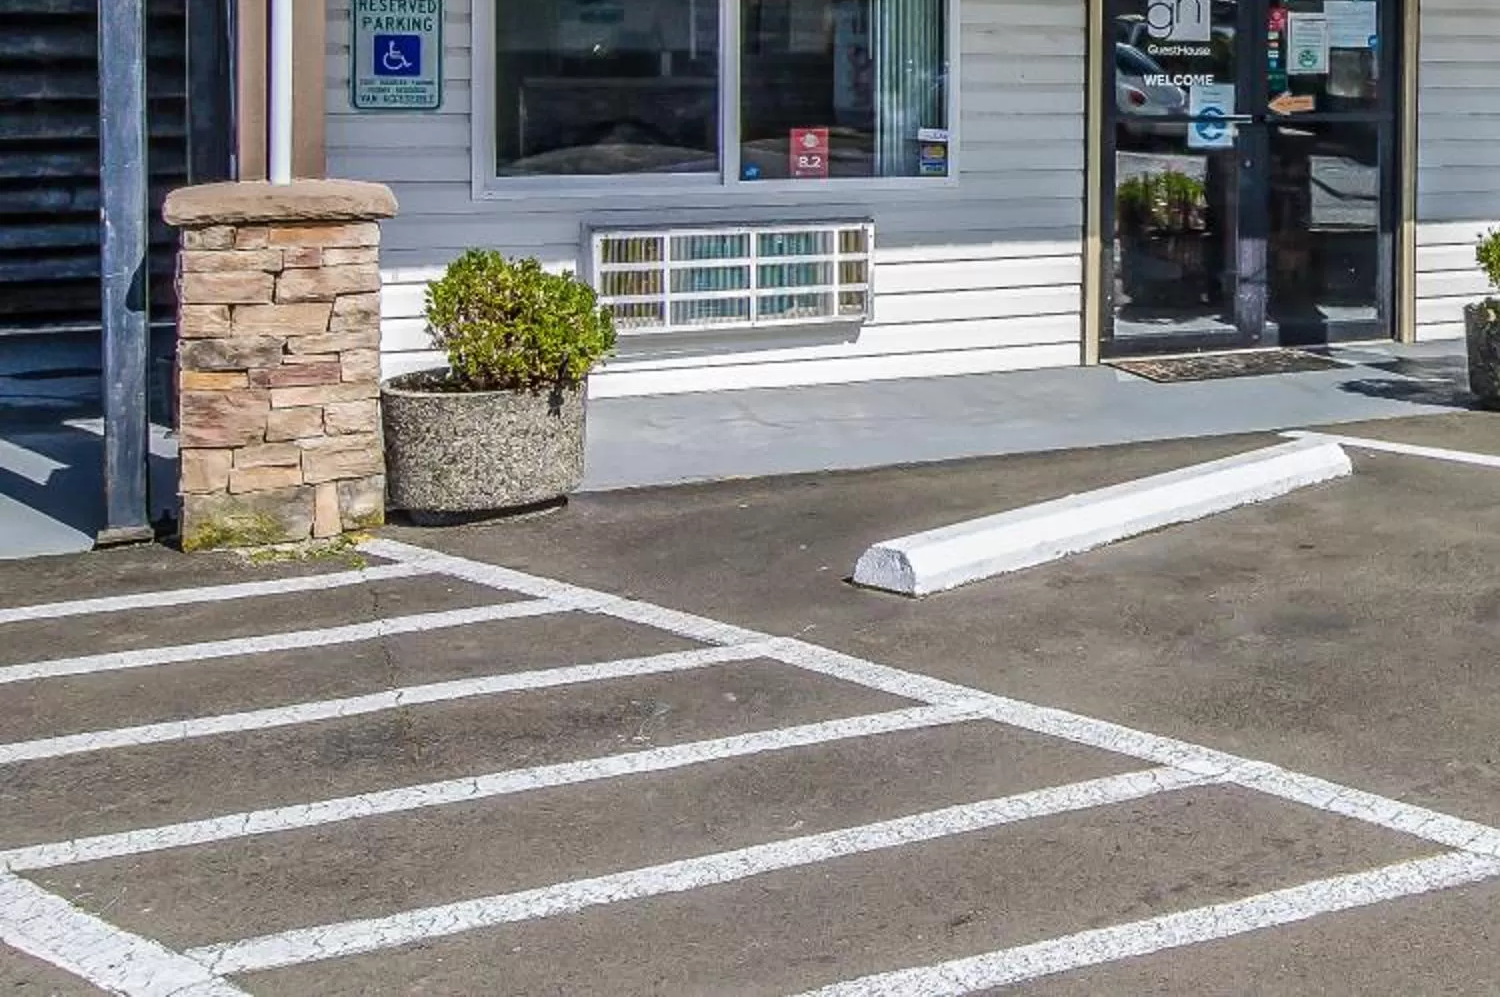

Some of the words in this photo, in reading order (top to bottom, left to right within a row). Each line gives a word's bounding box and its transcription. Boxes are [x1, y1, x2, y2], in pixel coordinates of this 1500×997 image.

[361, 16, 434, 32] PARKING
[1148, 43, 1212, 56] GuestHouse
[1143, 73, 1216, 87] WELCOME
[799, 155, 822, 169] 8.2
